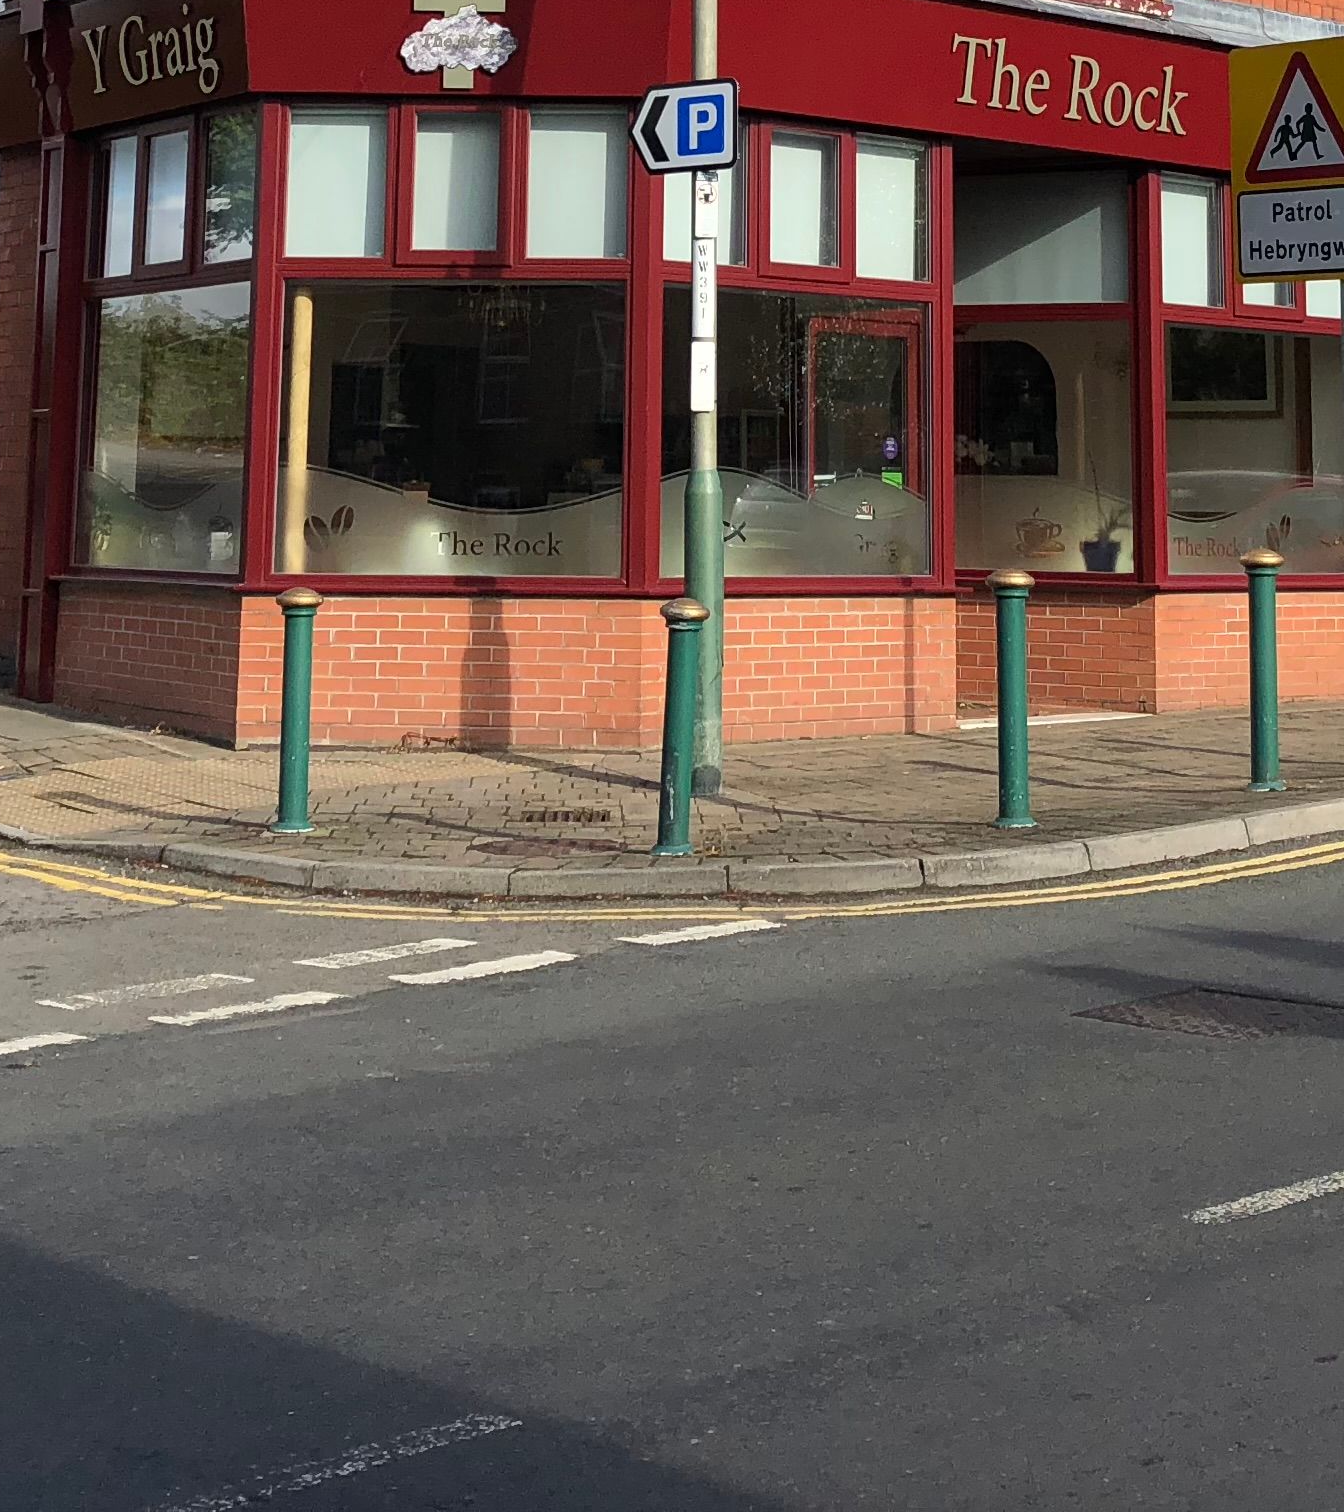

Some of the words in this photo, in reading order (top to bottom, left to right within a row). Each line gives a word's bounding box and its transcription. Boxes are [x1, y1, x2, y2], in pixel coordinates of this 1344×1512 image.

[81, 25, 106, 94] Y
[119, 3, 219, 94] Graig
[953, 33, 1050, 115] The
[1064, 54, 1188, 135] Rock
[689, 102, 718, 150] P
[1272, 199, 1333, 223] Patrol
[431, 531, 484, 556] The
[493, 532, 563, 556] Rock
[1174, 537, 1202, 556] The
[1207, 538, 1242, 558] Rock
